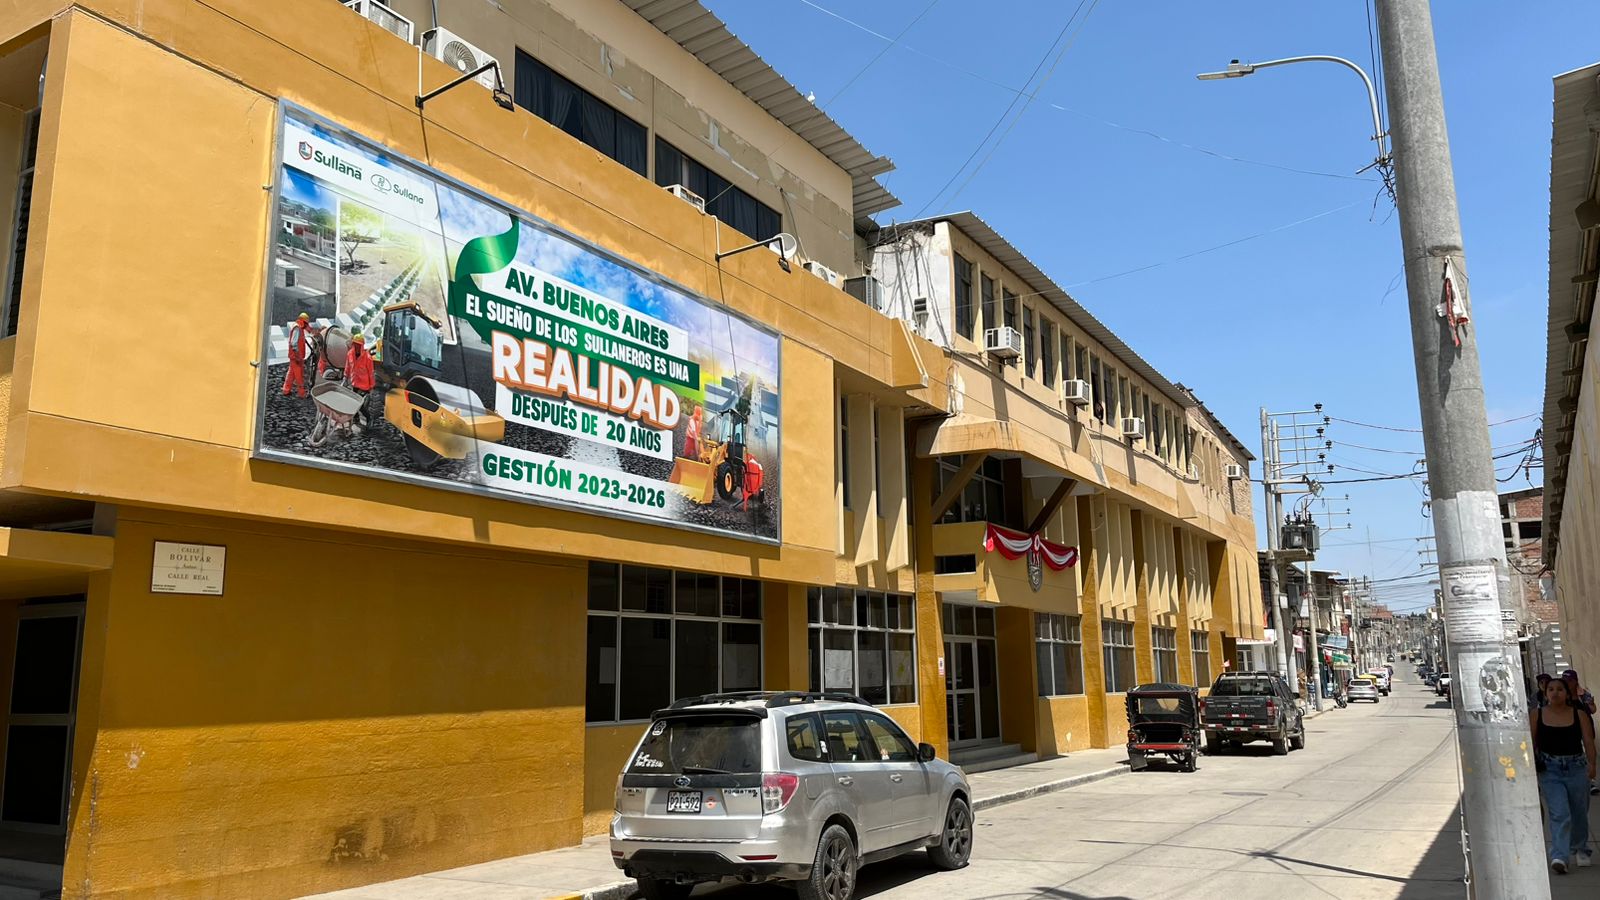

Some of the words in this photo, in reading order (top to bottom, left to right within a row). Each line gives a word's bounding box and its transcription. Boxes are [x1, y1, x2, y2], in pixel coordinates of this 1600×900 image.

[314, 150, 362, 181] Sullana
[393, 184, 424, 204] Sullana
[505, 267, 539, 300] AV.
[543, 281, 620, 331] BUENOS
[622, 315, 670, 350] AIRES
[465, 293, 483, 318] EL
[486, 299, 532, 331] SUEÑO
[535, 317, 552, 339] DE
[554, 323, 578, 347] LOS
[584, 333, 652, 371] SULLANEROS
[653, 358, 667, 376] ES
[669, 362, 690, 383] UNA
[491, 330, 681, 429] REALIDAD
[511, 393, 577, 431] DESPUÉS
[581, 412, 598, 436] DE
[606, 420, 626, 443] 20
[482, 453, 572, 490] GESTIÓN
[578, 473, 665, 509] 2023-2026
[167, 572, 190, 580] CALLE
[169, 553, 212, 563] BOLIVAR
